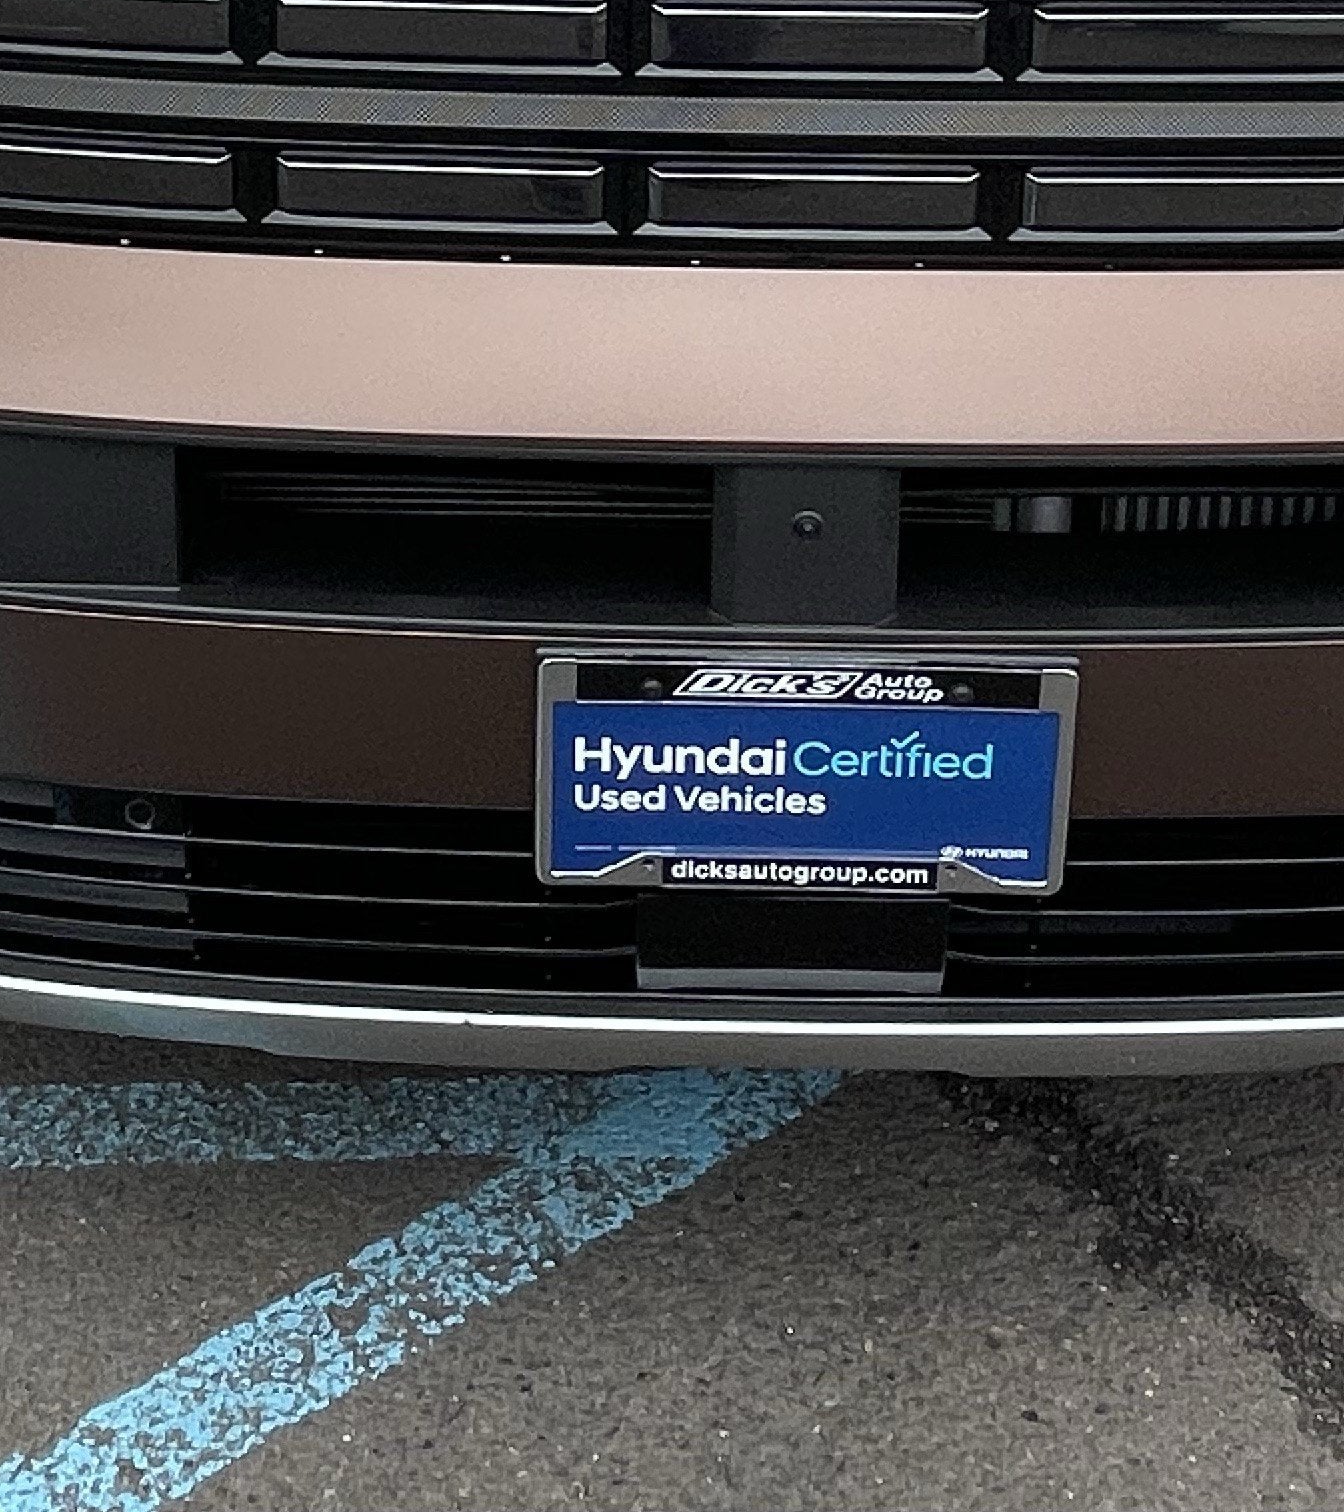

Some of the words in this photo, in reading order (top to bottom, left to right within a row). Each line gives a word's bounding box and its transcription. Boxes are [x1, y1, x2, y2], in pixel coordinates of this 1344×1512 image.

[868, 672, 933, 689] Auto
[855, 685, 943, 703] Group
[574, 736, 786, 779] Hyundai
[793, 731, 994, 779] Certified
[574, 785, 666, 811] Used
[673, 785, 826, 815] Vehicles
[671, 861, 928, 885] dicksautogroup.com
